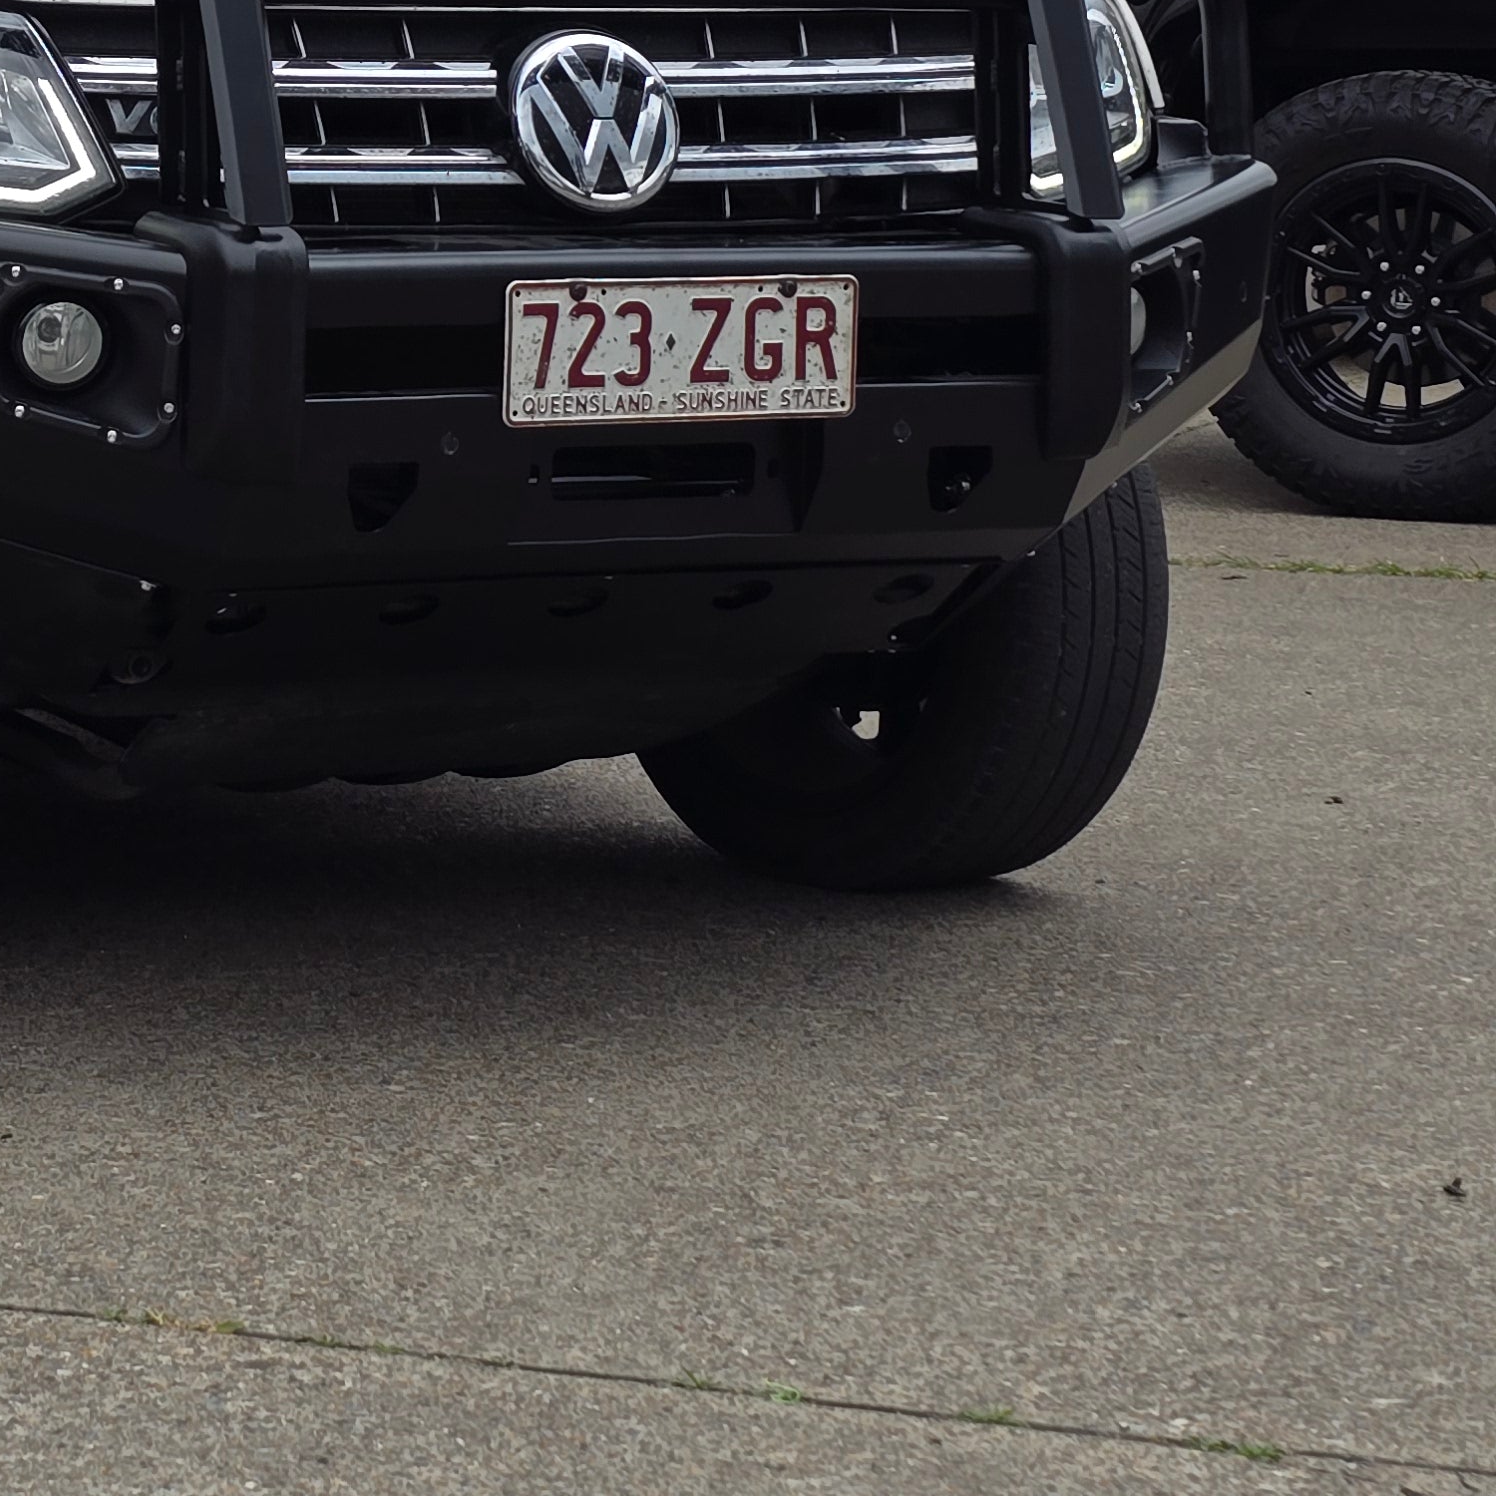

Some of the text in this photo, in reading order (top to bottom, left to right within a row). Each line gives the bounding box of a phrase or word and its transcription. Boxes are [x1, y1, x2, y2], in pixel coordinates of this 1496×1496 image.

[522, 296, 837, 389] 723 ZGR
[522, 392, 653, 416] QUEENSLAND
[677, 389, 769, 413] SUNSHINE
[780, 388, 839, 408] STATE
